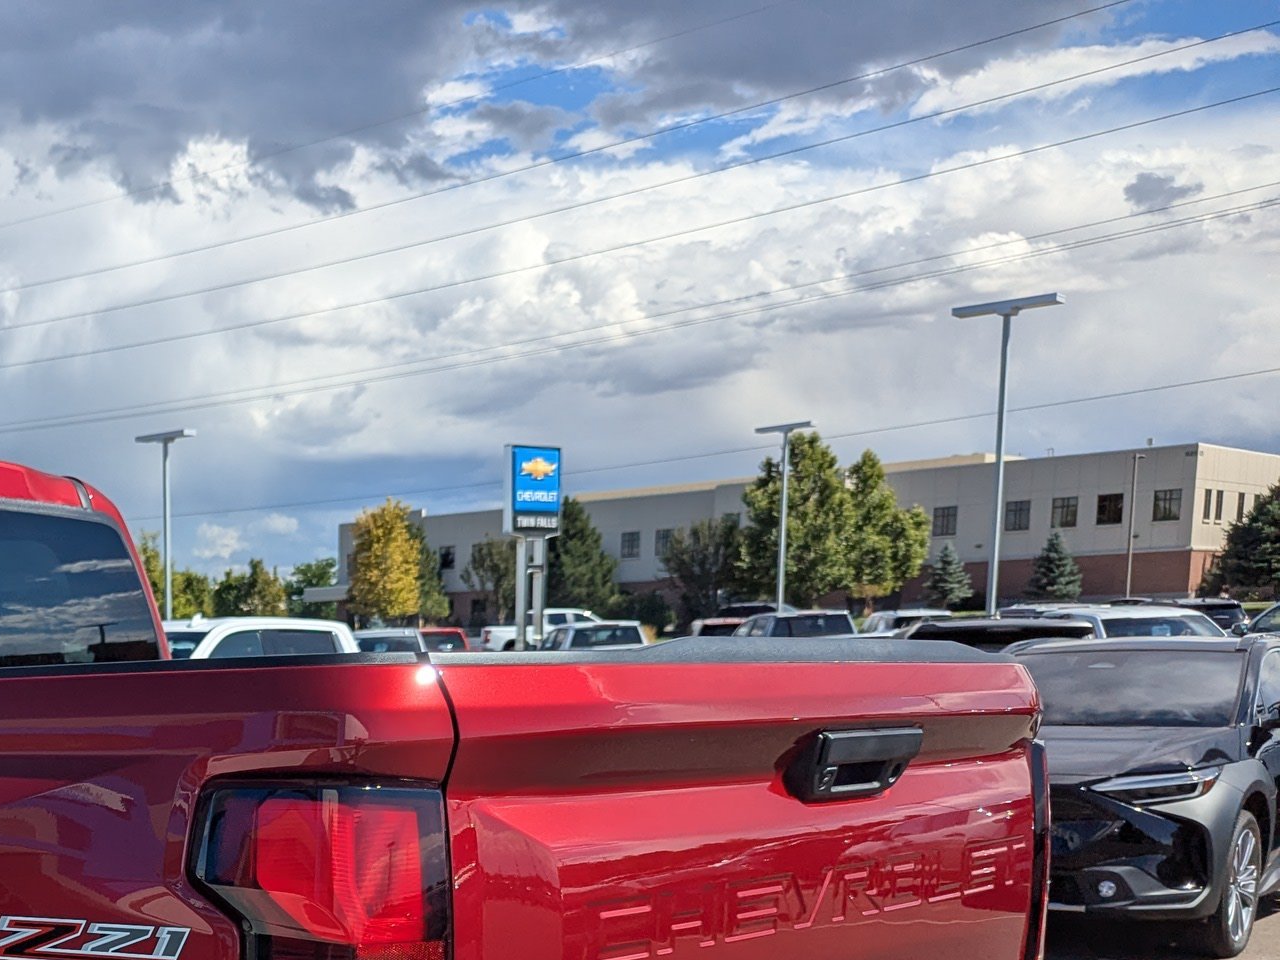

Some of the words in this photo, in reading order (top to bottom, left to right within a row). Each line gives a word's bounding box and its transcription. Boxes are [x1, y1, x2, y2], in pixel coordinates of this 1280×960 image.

[517, 491, 557, 502] CHEVROLET
[517, 516, 536, 528] TWIN
[536, 516, 558, 529] FALLS
